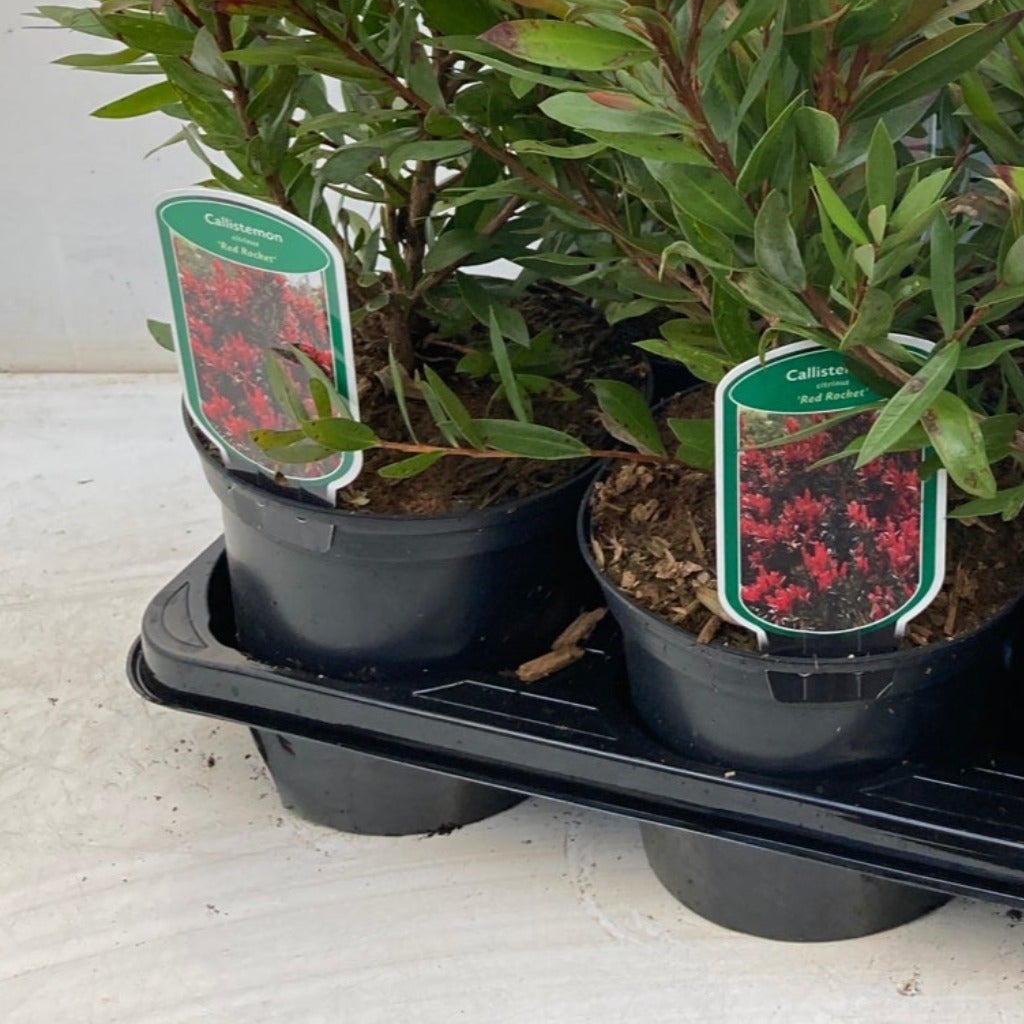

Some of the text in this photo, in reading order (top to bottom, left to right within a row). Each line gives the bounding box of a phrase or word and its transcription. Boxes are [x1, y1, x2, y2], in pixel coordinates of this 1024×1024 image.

[204, 213, 284, 243] Callistemon
[786, 366, 849, 381] Calliste
[797, 388, 869, 404] 'Red Rocket'
